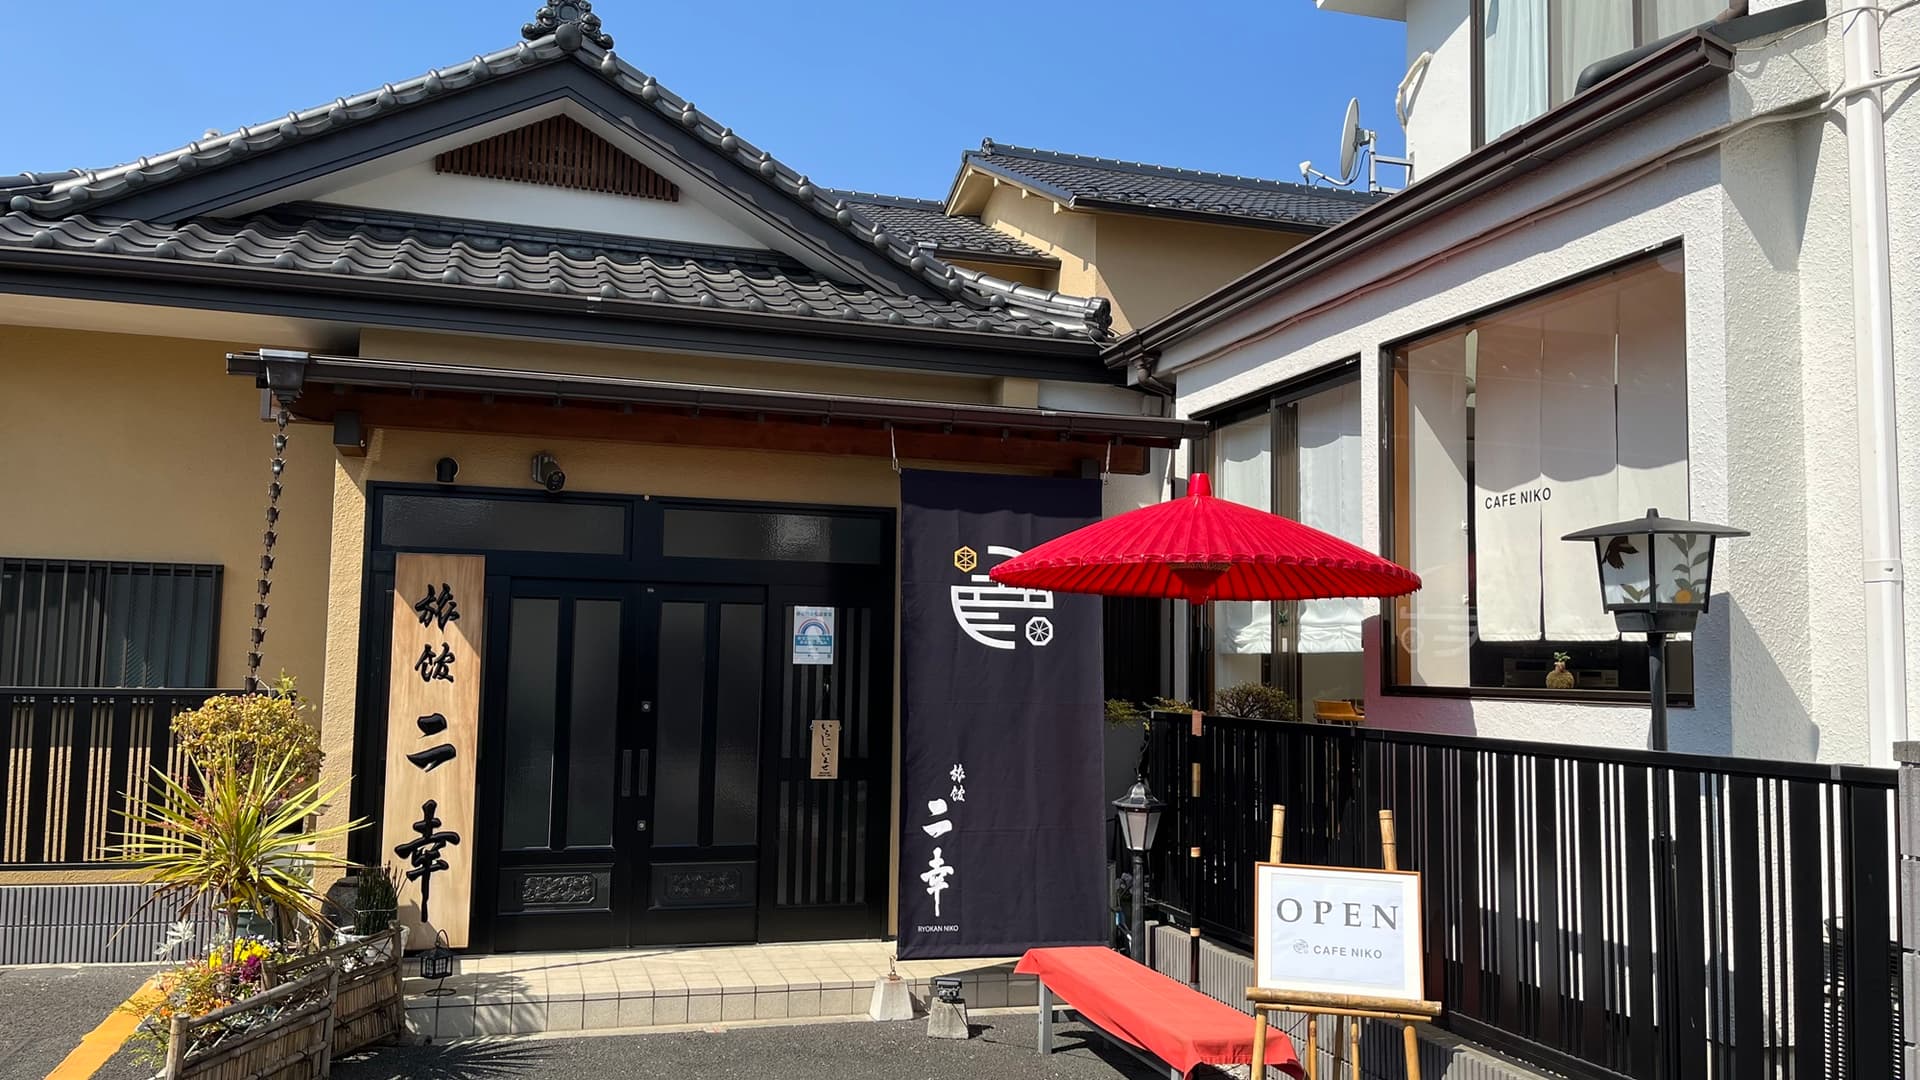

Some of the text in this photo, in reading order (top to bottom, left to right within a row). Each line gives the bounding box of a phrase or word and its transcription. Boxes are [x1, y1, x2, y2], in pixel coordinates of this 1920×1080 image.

[1485, 487, 1552, 510] CAFE NIKO
[919, 798, 955, 917] 二幸
[1276, 897, 1398, 931] OPEN
[917, 924, 959, 933] RYOKAN NIKO
[1313, 945, 1383, 959] CAFE NIKO
